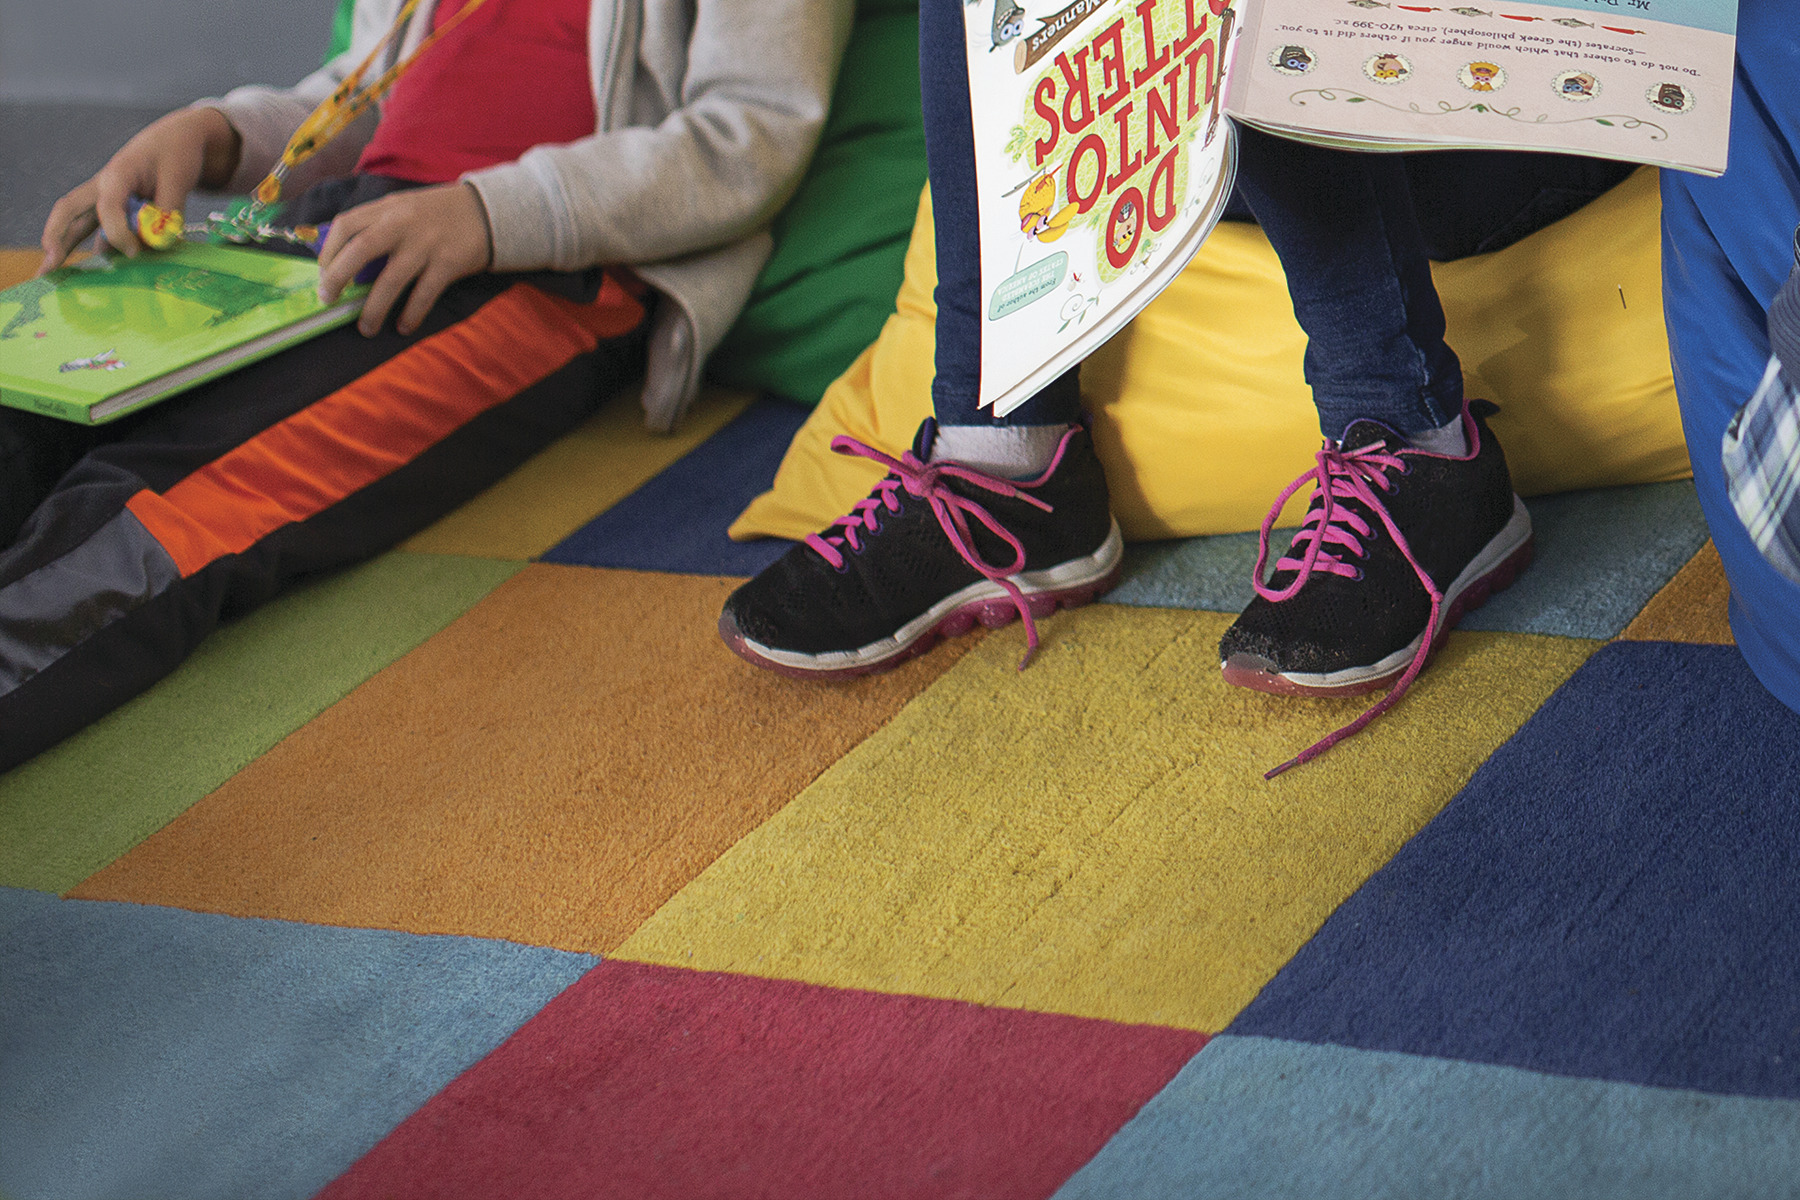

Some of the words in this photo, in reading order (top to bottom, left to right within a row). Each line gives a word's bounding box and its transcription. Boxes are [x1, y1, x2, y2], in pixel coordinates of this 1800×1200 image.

[1407, 25, 1437, 33] circa
[1441, 26, 1515, 40] philosopher),
[1336, 30, 1356, 38] did
[1359, 32, 1397, 41] others
[1439, 37, 1473, 46] anger
[1519, 34, 1554, 45] Greek
[1558, 39, 1582, 48] (the
[1476, 42, 1511, 50] would
[1515, 45, 1549, 55] which
[1553, 49, 1579, 58] that
[1583, 53, 1620, 63] others
[1624, 58, 1636, 66] to
[1640, 61, 1655, 69] do
[1658, 63, 1678, 72] not
[1067, 37, 1215, 214] UNTO
[1105, 144, 1179, 269] DO
